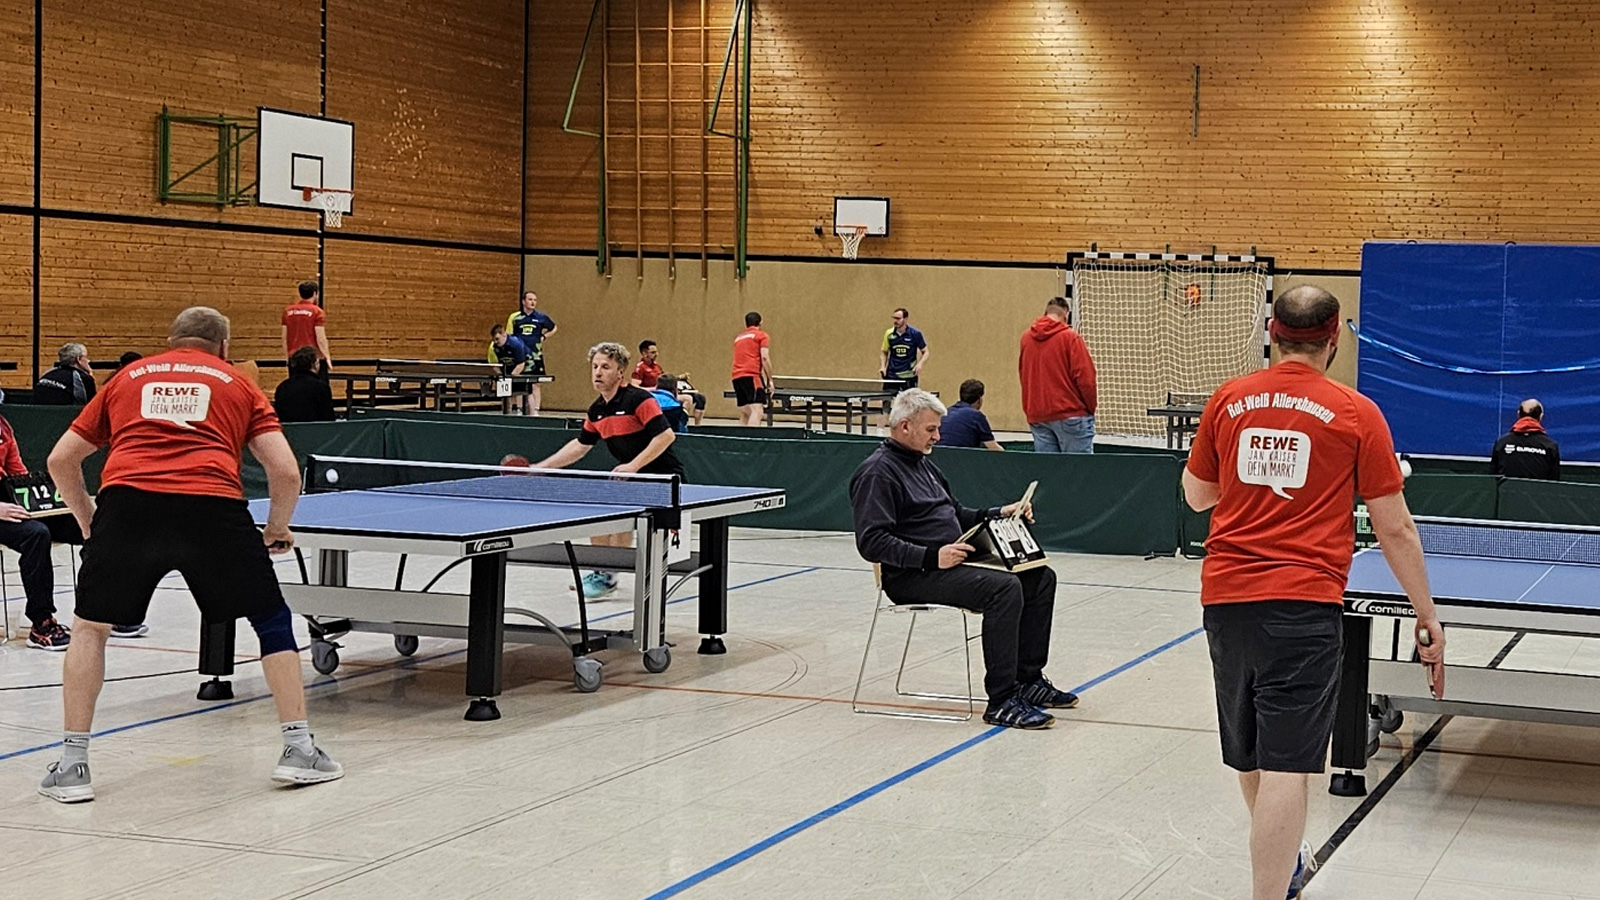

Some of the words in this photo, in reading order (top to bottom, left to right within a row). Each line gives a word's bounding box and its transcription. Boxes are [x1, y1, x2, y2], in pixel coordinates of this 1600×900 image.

[153, 387, 200, 396] REWE
[150, 404, 168, 414] DEIN
[172, 404, 198, 414] MARKT
[1226, 392, 1270, 419] Rot-Weiß
[1272, 392, 1336, 424] Allershausen
[1250, 435, 1299, 452] REWE
[1248, 451, 1264, 460] JAN
[1269, 451, 1297, 462] KAISER
[1247, 461, 1267, 476] DEIN
[1270, 462, 1296, 478] MARKT
[14, 487, 30, 510] 7
[1369, 605, 1416, 616] cornillea
